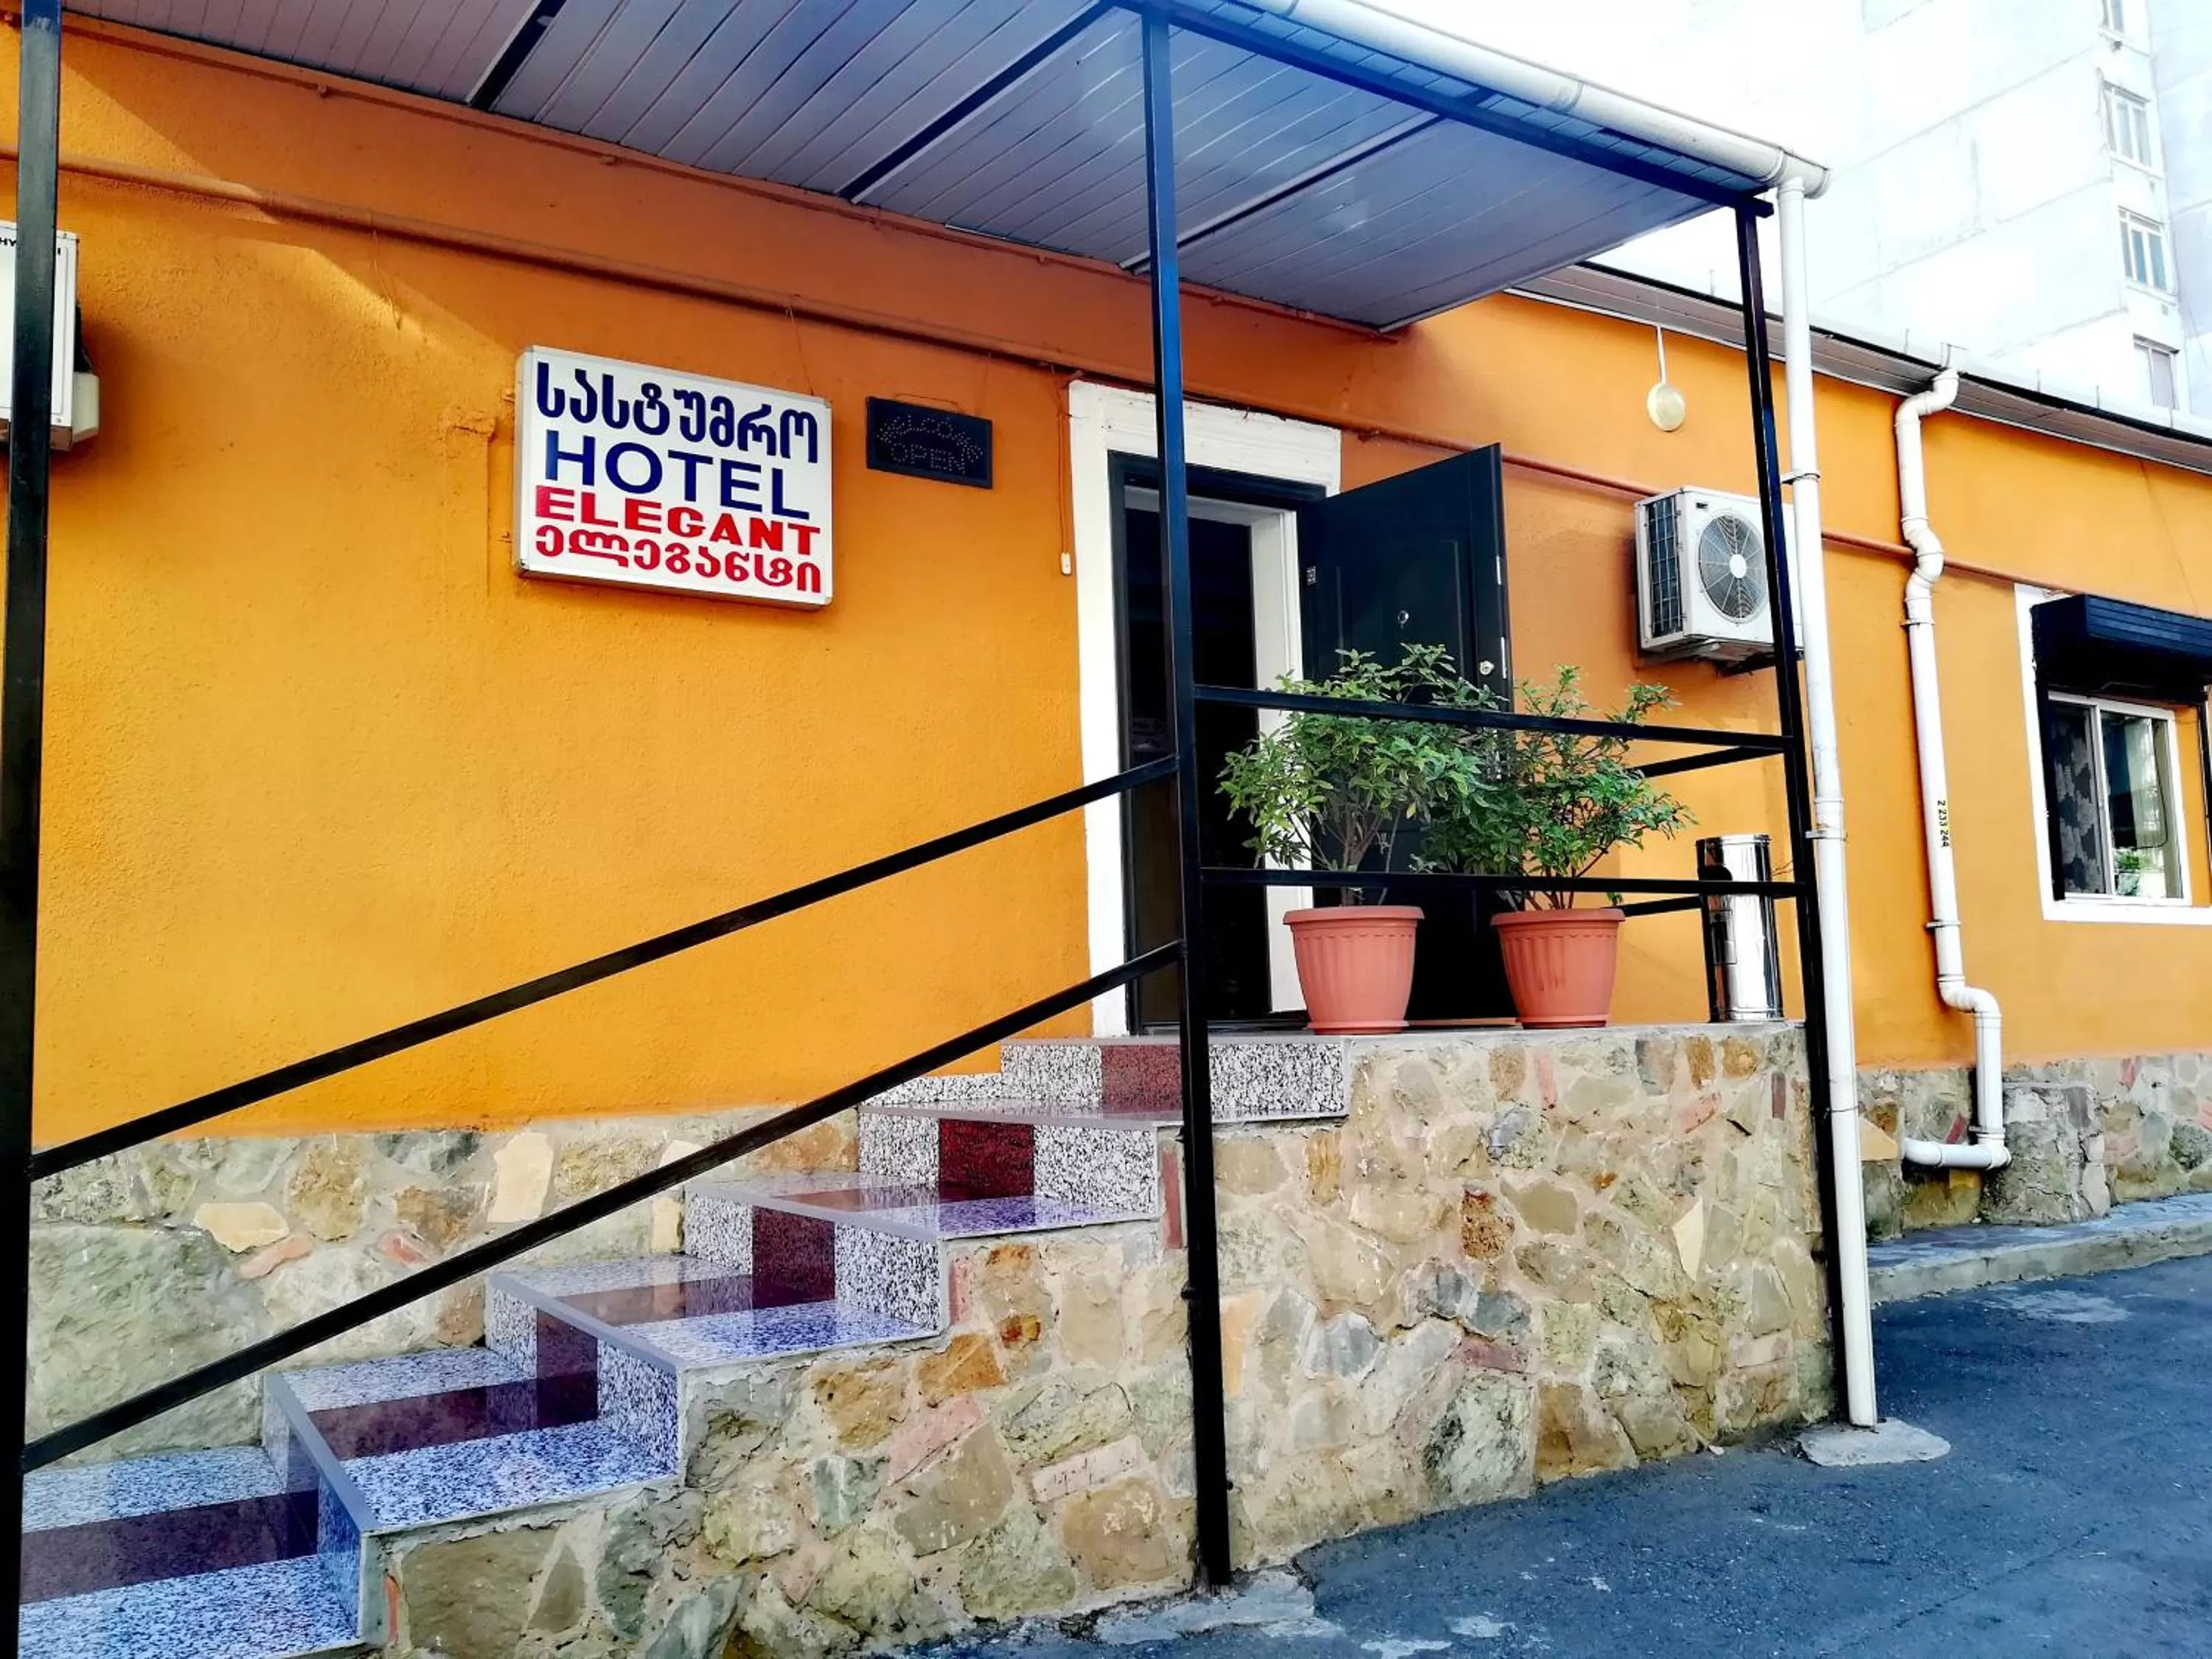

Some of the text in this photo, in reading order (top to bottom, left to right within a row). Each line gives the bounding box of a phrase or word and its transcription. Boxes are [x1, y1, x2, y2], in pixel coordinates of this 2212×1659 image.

[536, 361, 818, 464] სასტუმრო
[545, 429, 810, 521] HOTEL
[890, 442, 966, 476] OPEN
[535, 484, 821, 555] ELEGANT
[535, 524, 821, 594] ელეგანტი
